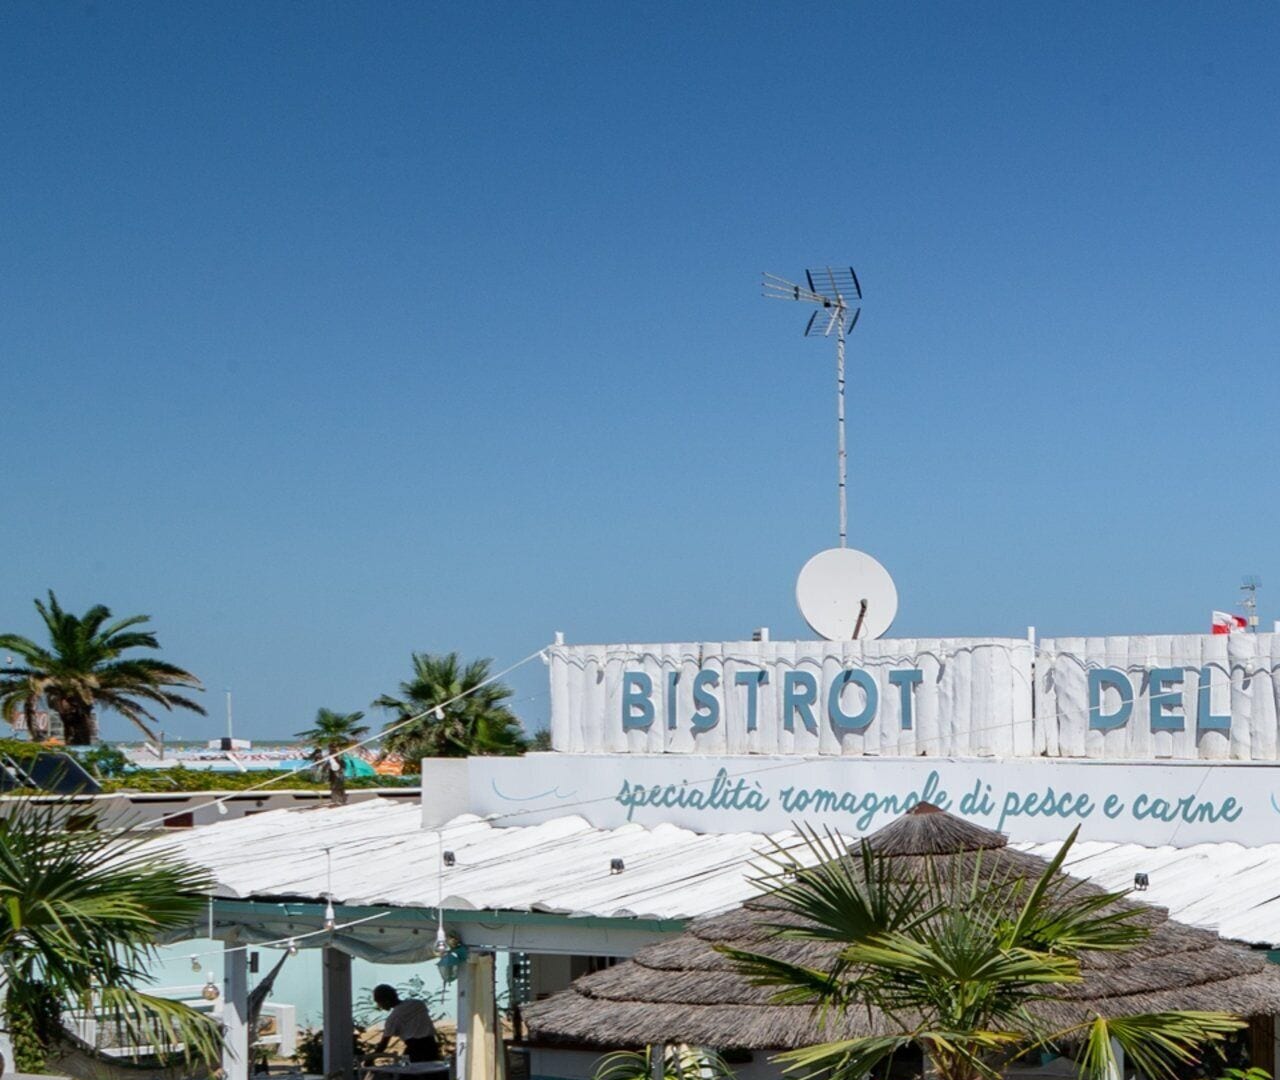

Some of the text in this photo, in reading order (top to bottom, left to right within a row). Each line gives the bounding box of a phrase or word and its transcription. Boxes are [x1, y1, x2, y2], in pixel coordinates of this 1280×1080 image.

[622, 668, 924, 730] BISTROT
[1089, 667, 1232, 730] DEL
[616, 767, 1243, 832] specialità romagnole di pesce e carne
